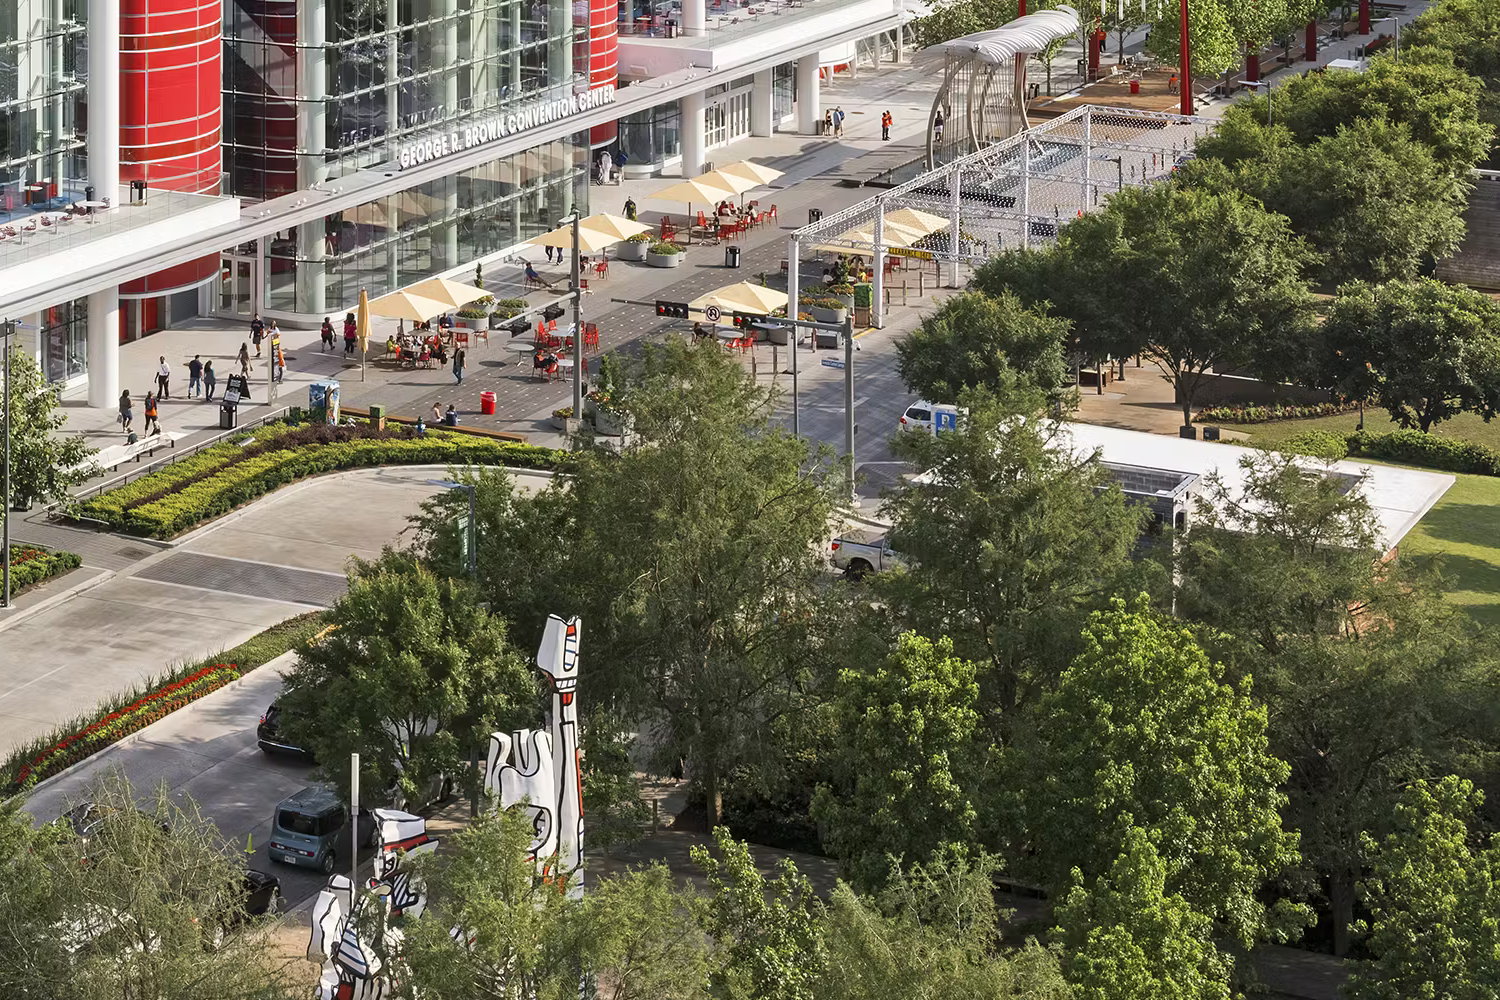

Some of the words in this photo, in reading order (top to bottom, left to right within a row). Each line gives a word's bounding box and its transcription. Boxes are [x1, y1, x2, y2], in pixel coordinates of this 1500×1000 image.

[400, 136, 448, 168] GEORGE
[451, 132, 462, 153] R.
[465, 117, 505, 148] BROWN
[508, 95, 577, 134] CONVENTION
[578, 83, 616, 110] CENTER
